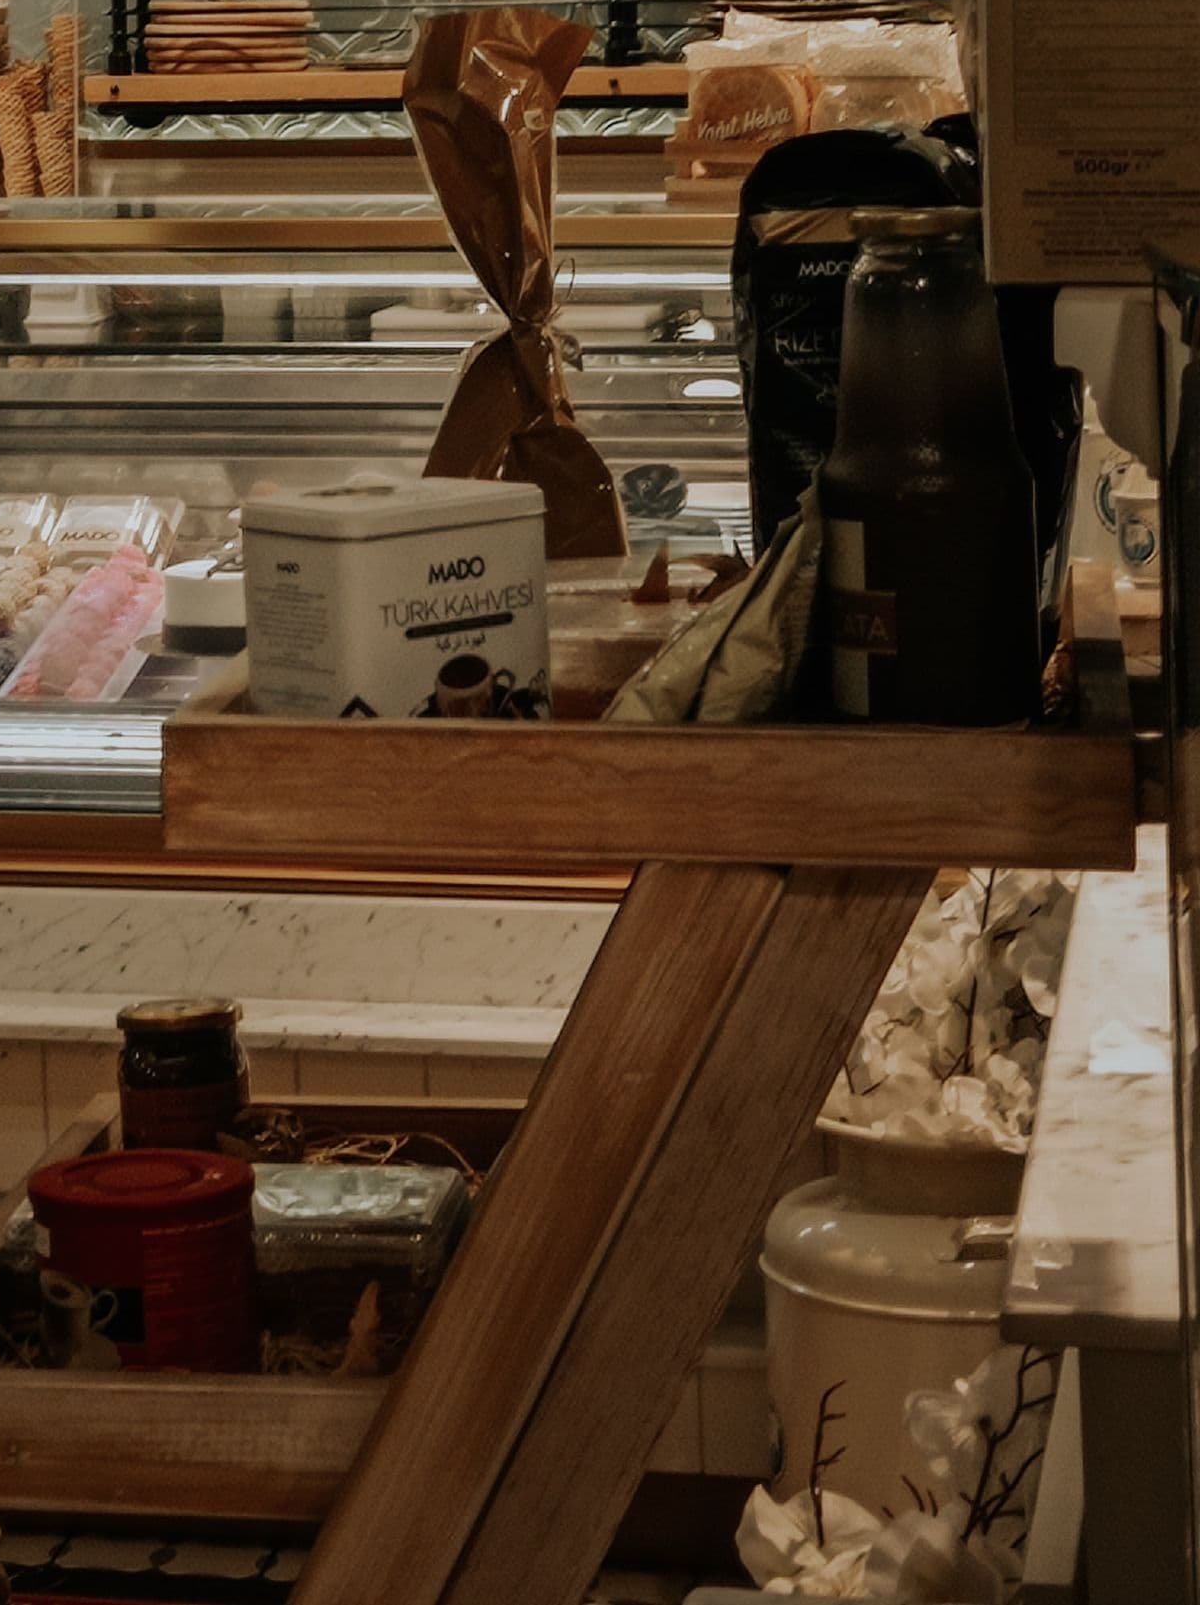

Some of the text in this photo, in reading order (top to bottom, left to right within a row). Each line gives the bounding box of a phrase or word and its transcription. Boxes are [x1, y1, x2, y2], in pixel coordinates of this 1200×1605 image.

[742, 103, 793, 134] Helva
[61, 530, 120, 542] MADO
[428, 555, 486, 585] MADO
[379, 578, 536, 628] TÜRK KAHVESİ
